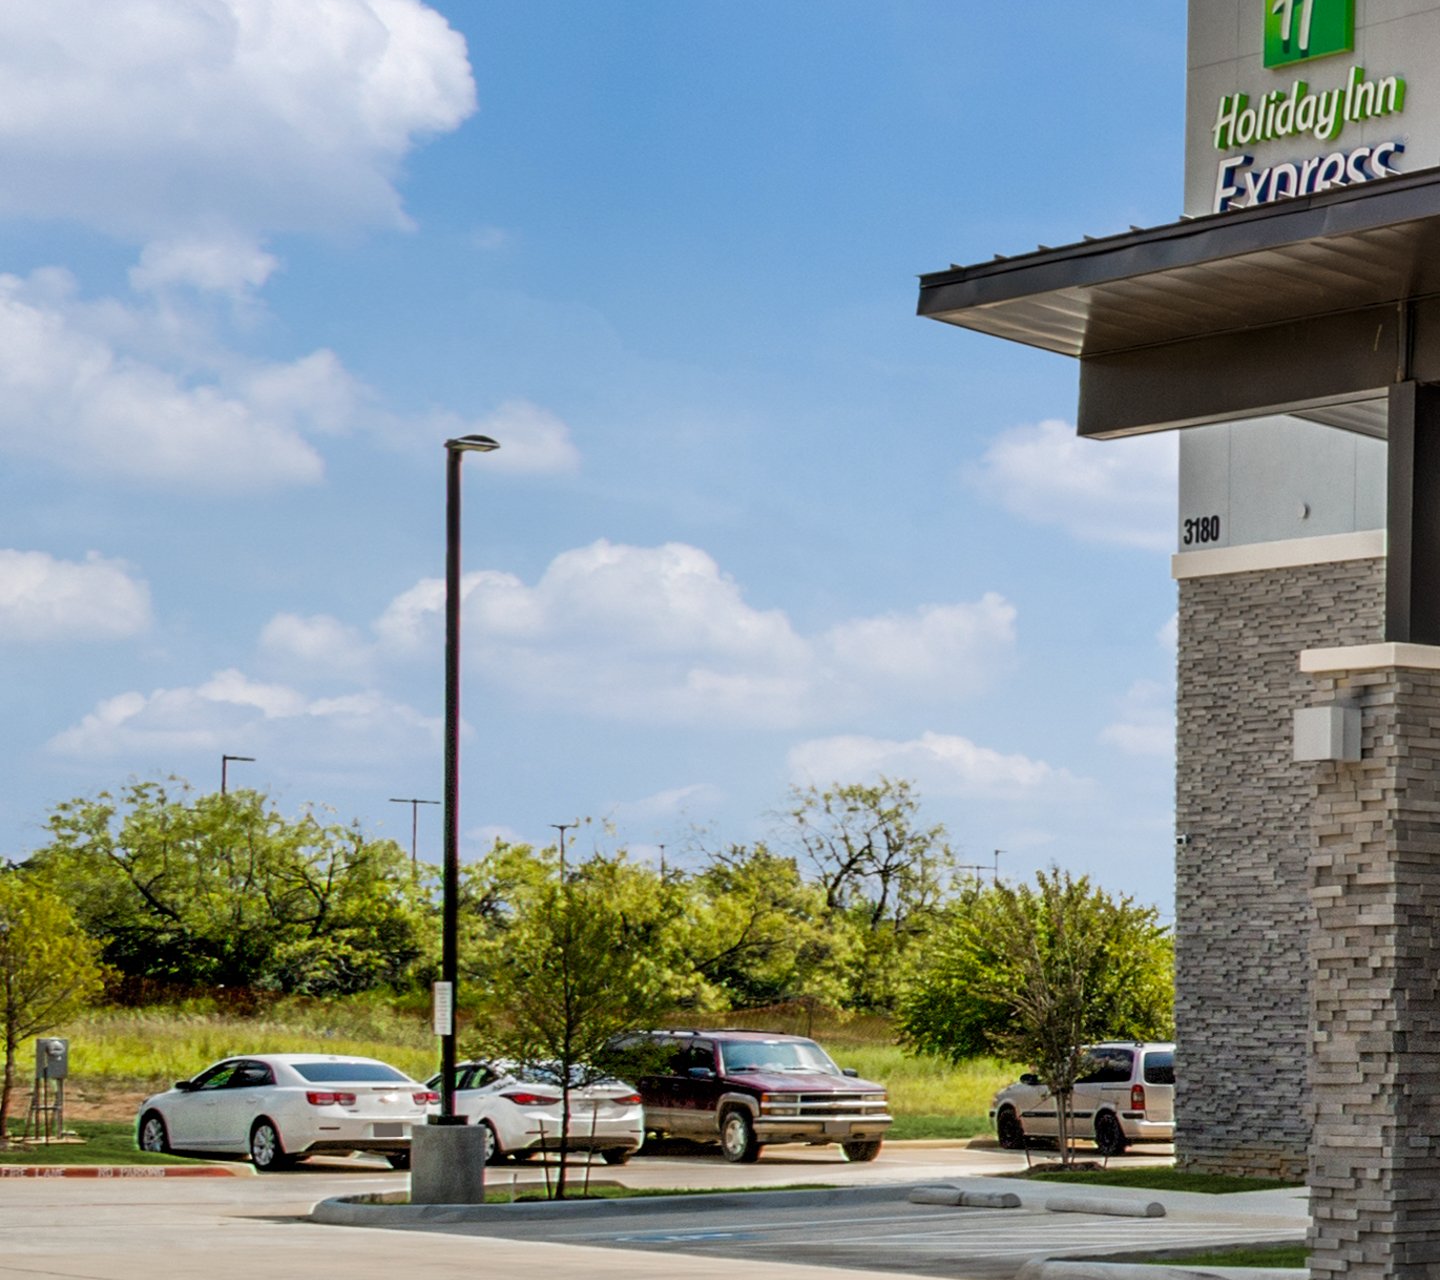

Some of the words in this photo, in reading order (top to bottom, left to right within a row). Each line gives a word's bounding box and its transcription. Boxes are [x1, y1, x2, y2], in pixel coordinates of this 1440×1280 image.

[1212, 80, 1344, 150] Holiday
[1344, 66, 1406, 122] Inn
[1183, 515, 1220, 545] 3180
